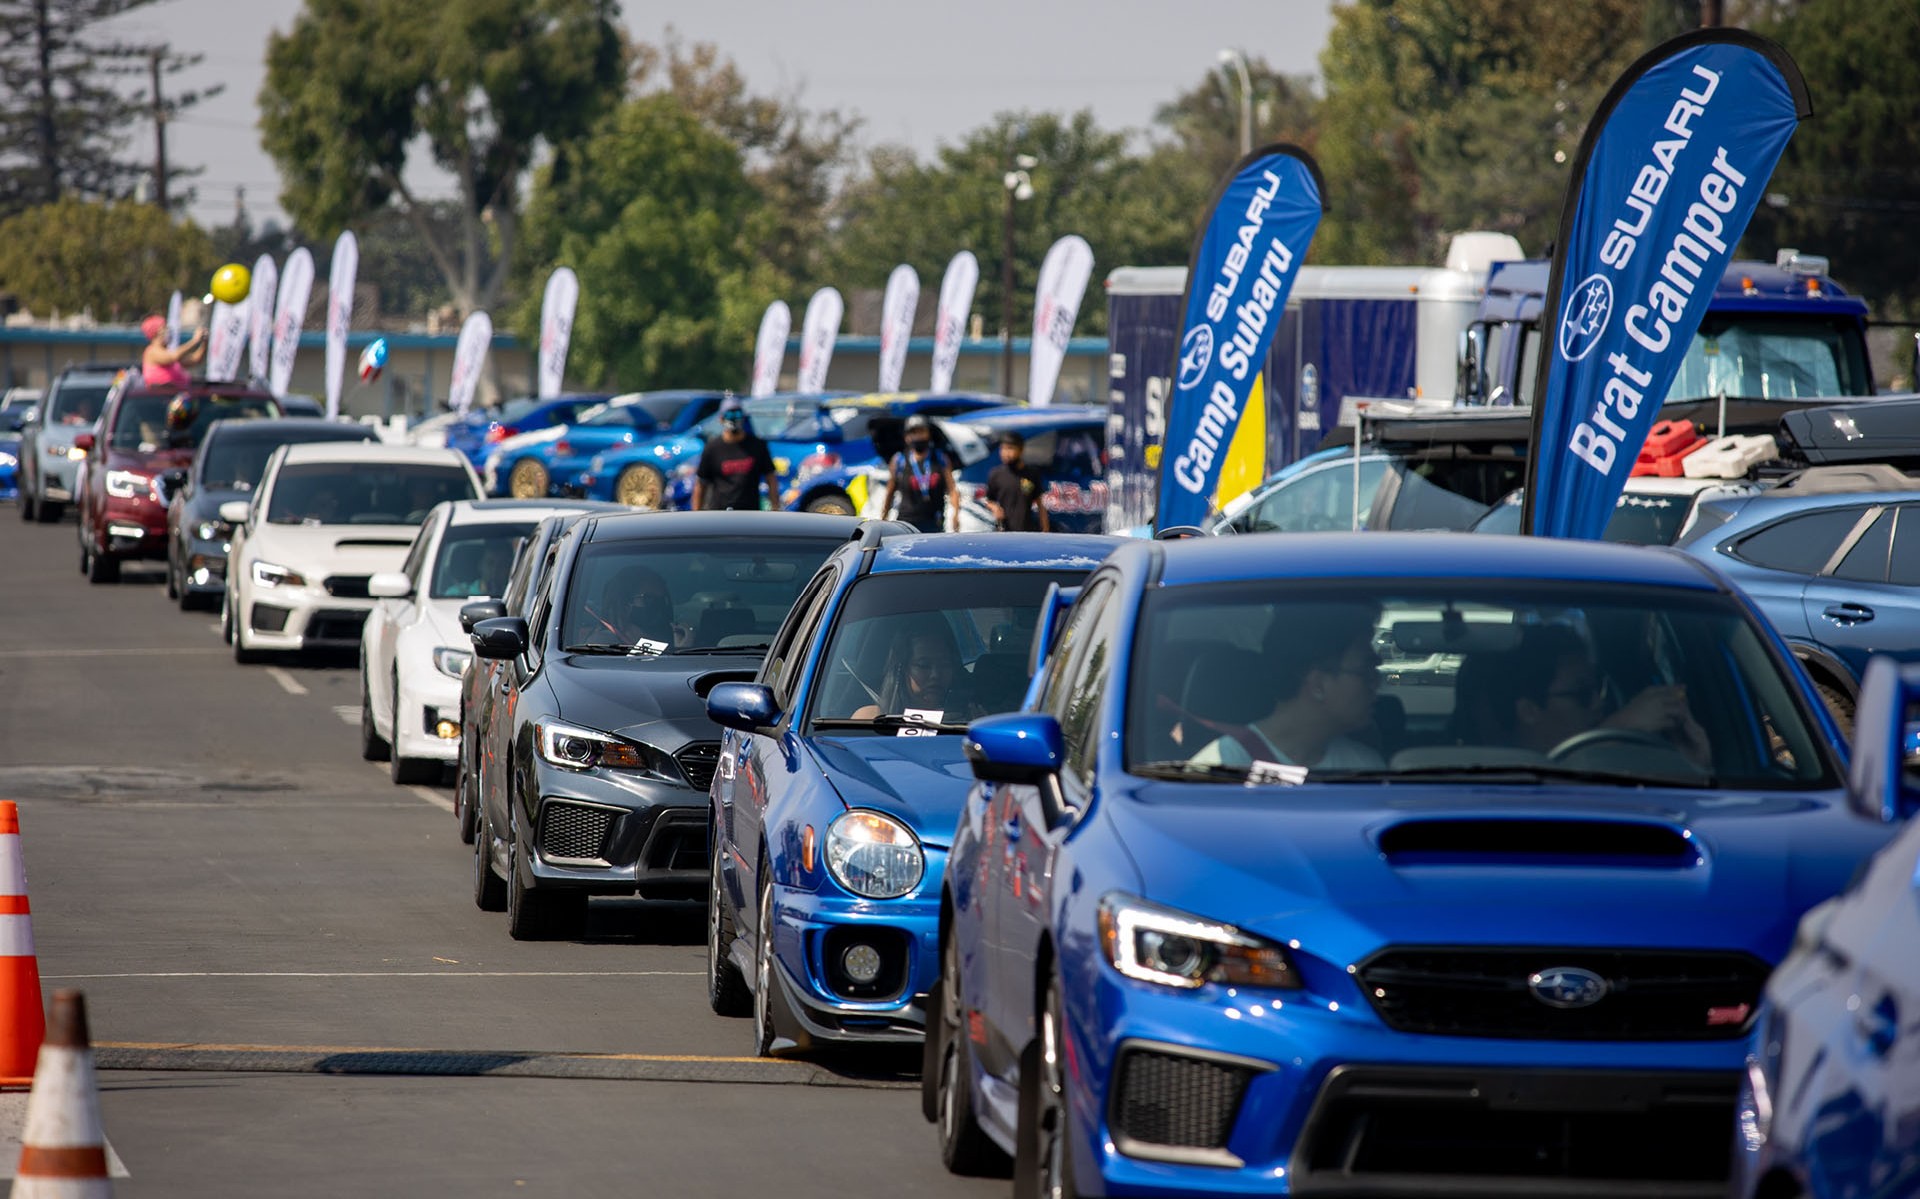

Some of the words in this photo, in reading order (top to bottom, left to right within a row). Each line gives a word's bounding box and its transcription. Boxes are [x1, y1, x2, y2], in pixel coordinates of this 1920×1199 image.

[1206, 169, 1281, 323] SUBARU
[1600, 64, 1720, 270] SUBARU
[1174, 380, 1238, 494] Camp
[1219, 237, 1293, 381] Subaru
[1569, 351, 1653, 477] Brat
[1624, 146, 1747, 353] Camper
